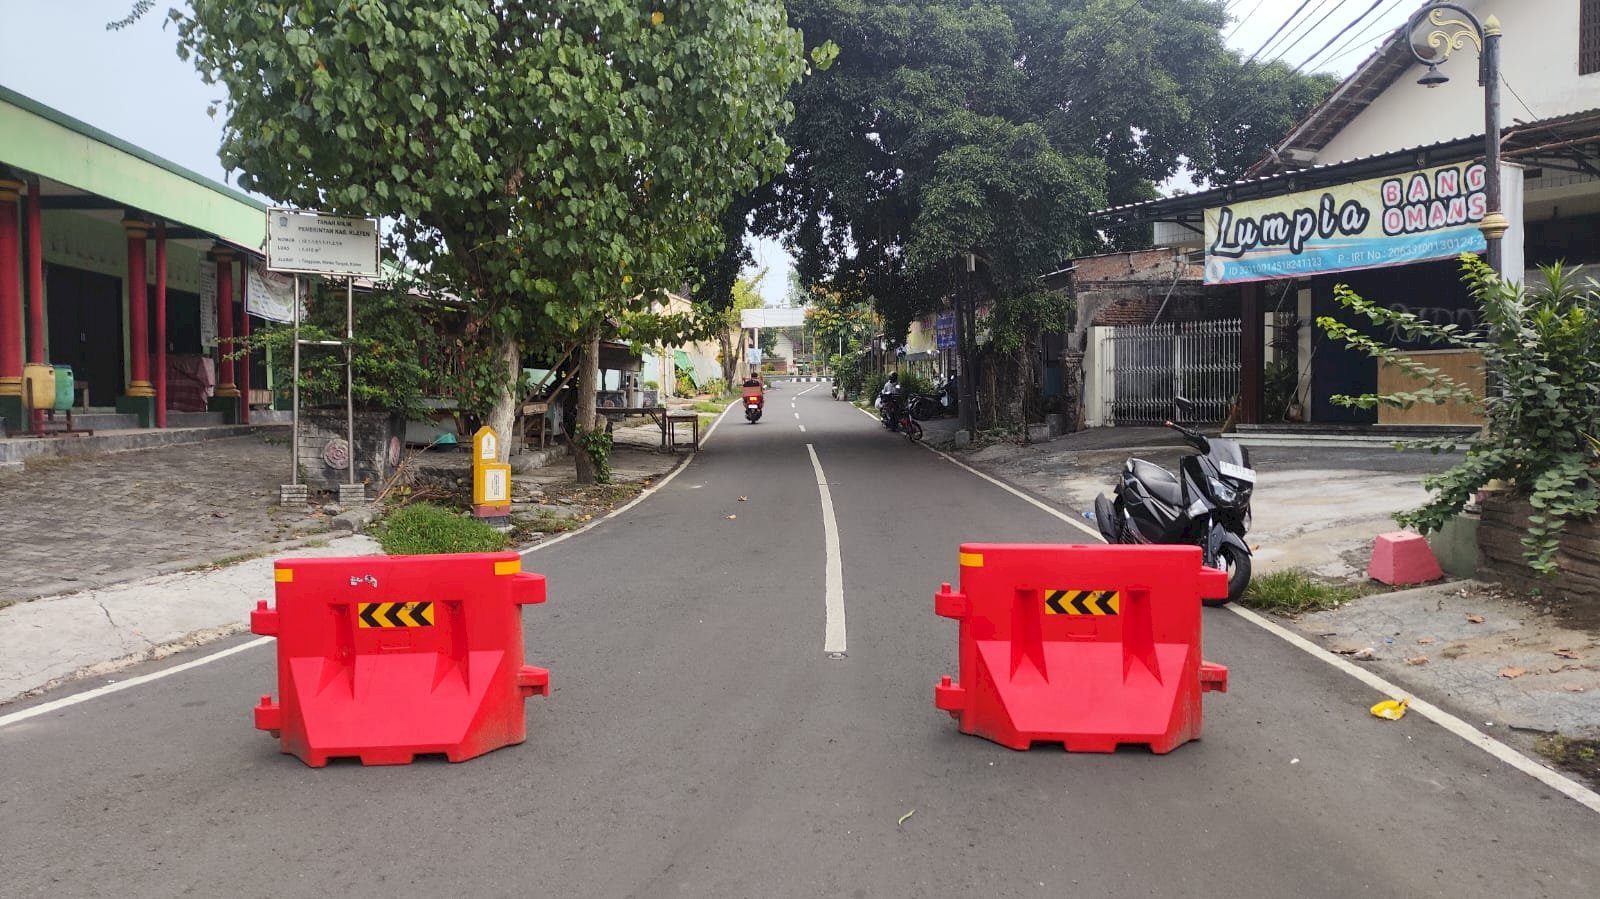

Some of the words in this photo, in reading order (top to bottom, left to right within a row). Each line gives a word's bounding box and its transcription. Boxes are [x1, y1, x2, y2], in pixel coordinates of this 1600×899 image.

[1382, 162, 1486, 207] BANG
[1211, 193, 1370, 258] Lumpia
[1383, 192, 1486, 235] OMANS
[298, 226, 334, 234] PEMERINTAH
[1229, 265, 1238, 275] ID
[1351, 251, 1364, 262] IRT
